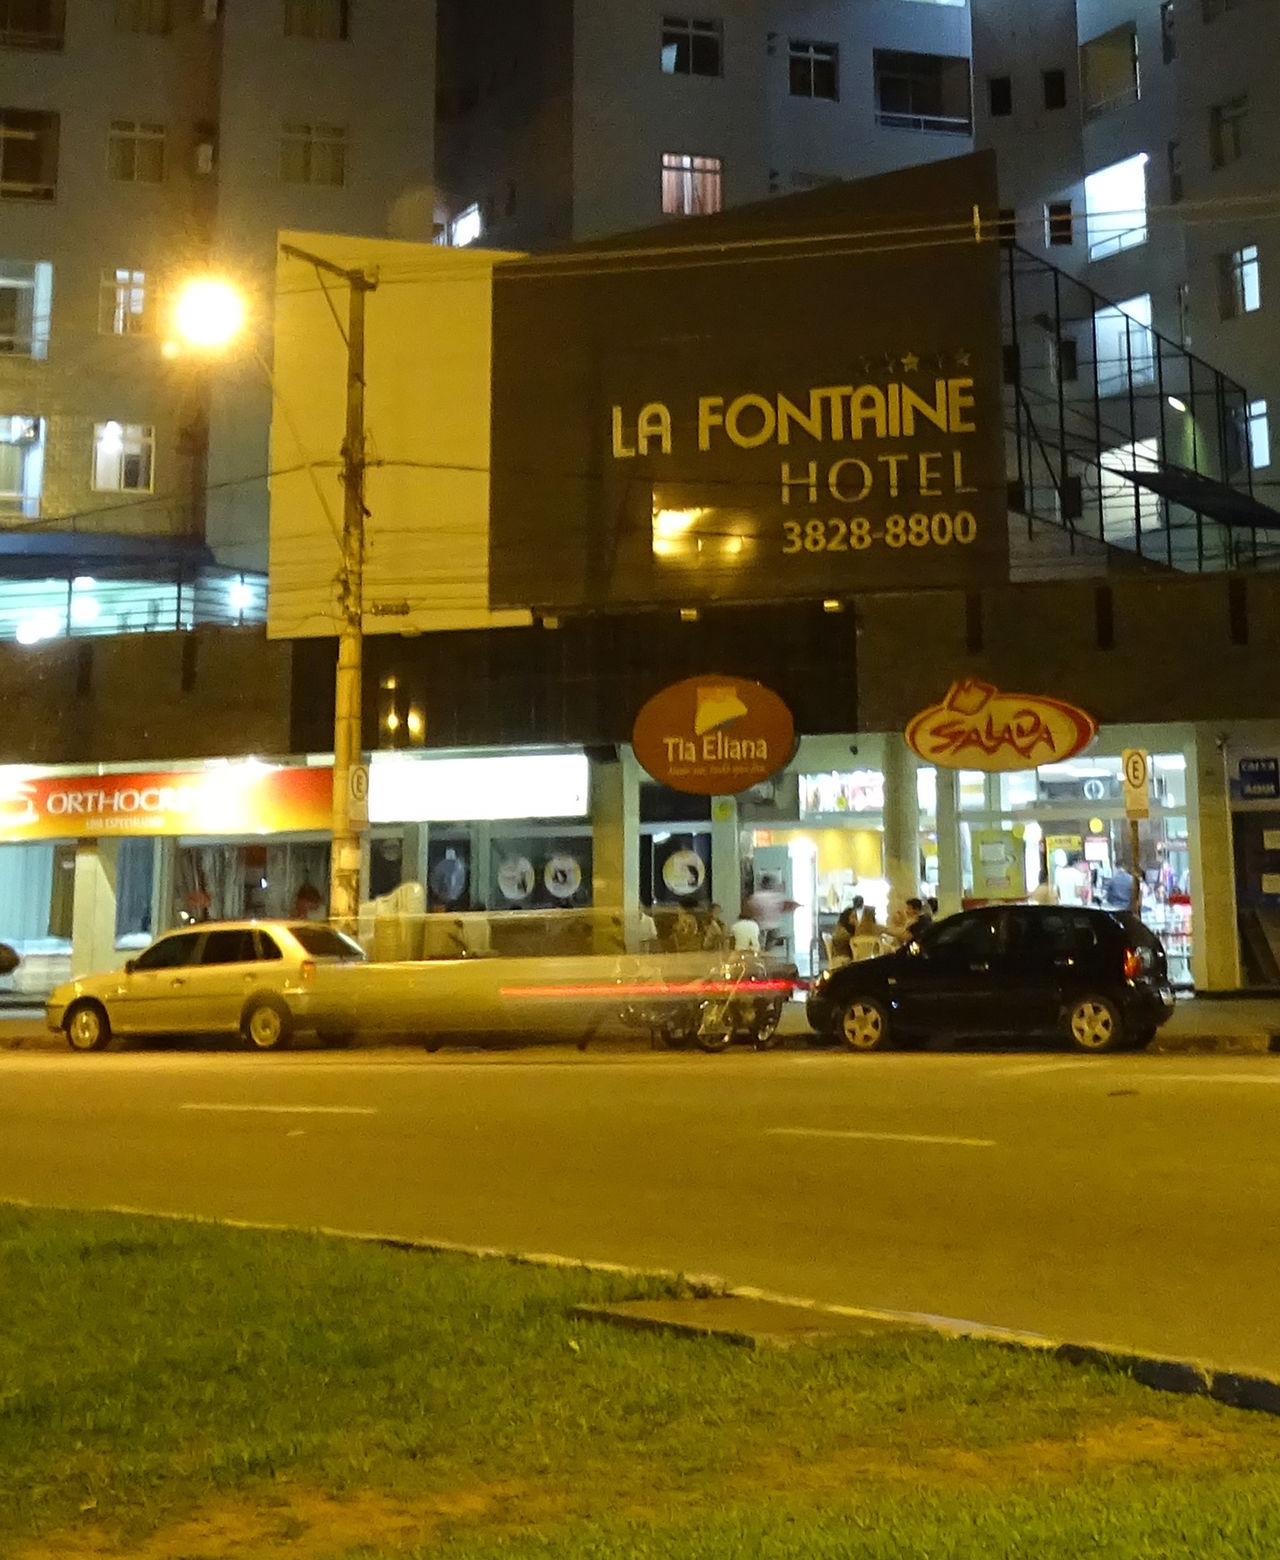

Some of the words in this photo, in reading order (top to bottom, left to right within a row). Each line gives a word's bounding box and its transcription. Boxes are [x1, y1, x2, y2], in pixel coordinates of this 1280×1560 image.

[612, 403, 672, 458] LA
[698, 377, 976, 451] FONTAINE
[781, 449, 979, 505] HOTEL
[781, 510, 978, 554] 3828-8800
[663, 736, 697, 763] Tia
